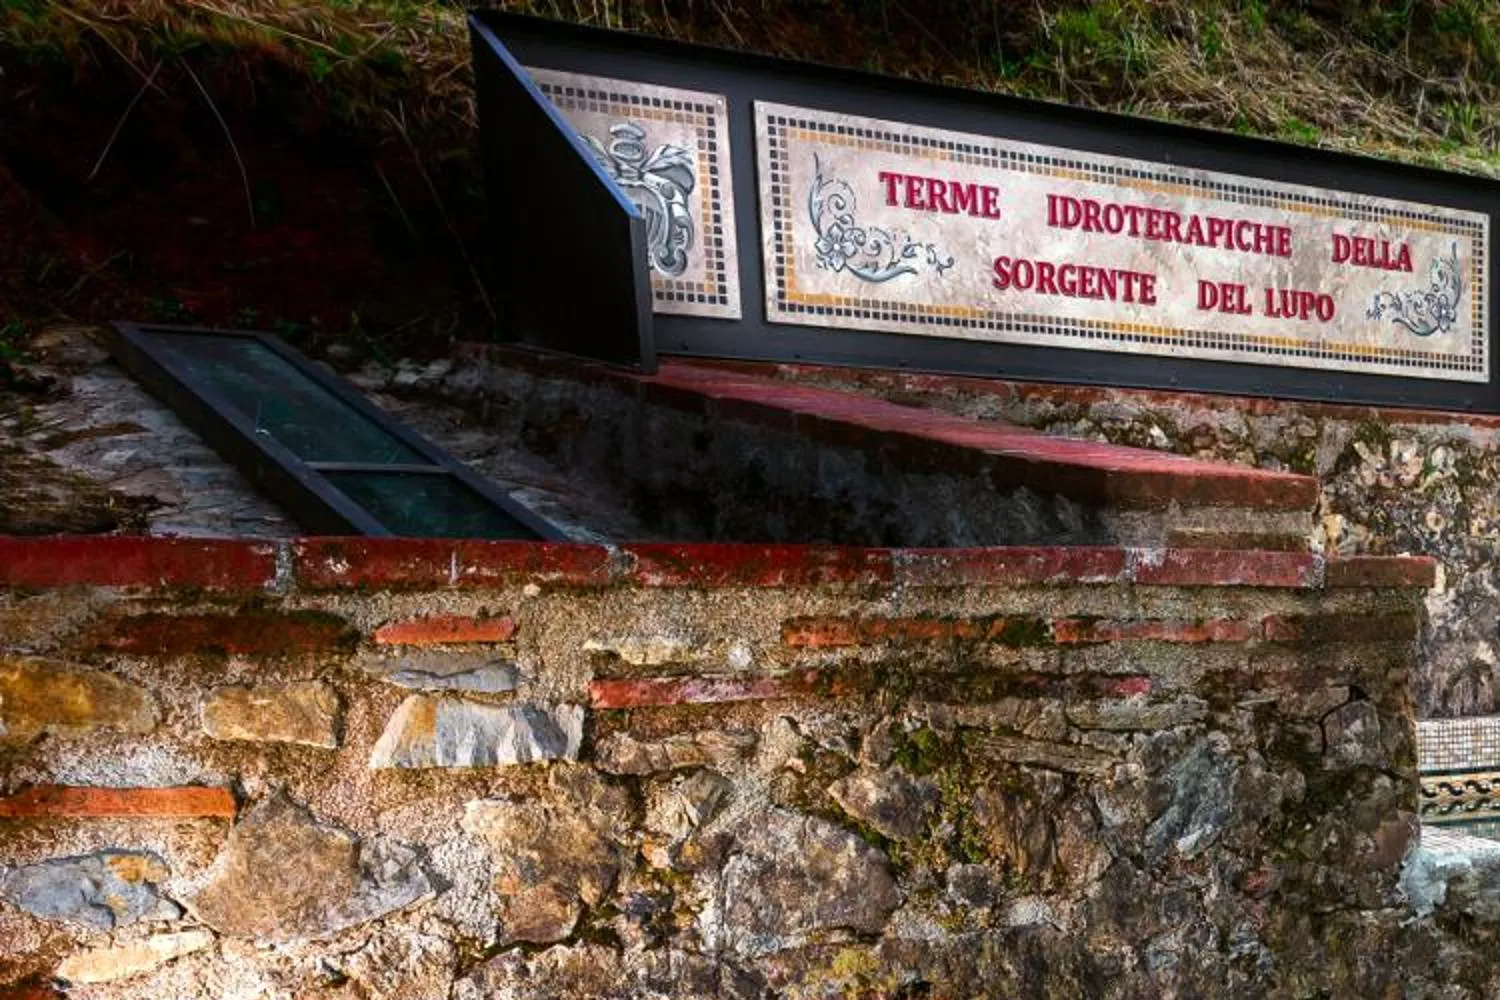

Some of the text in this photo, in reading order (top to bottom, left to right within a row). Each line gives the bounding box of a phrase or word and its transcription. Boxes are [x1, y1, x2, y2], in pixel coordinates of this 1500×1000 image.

[879, 171, 1414, 272] TERME IDROTERAPICHE DELLA
[993, 255, 1336, 322] SORGENTE DEL LUPO
